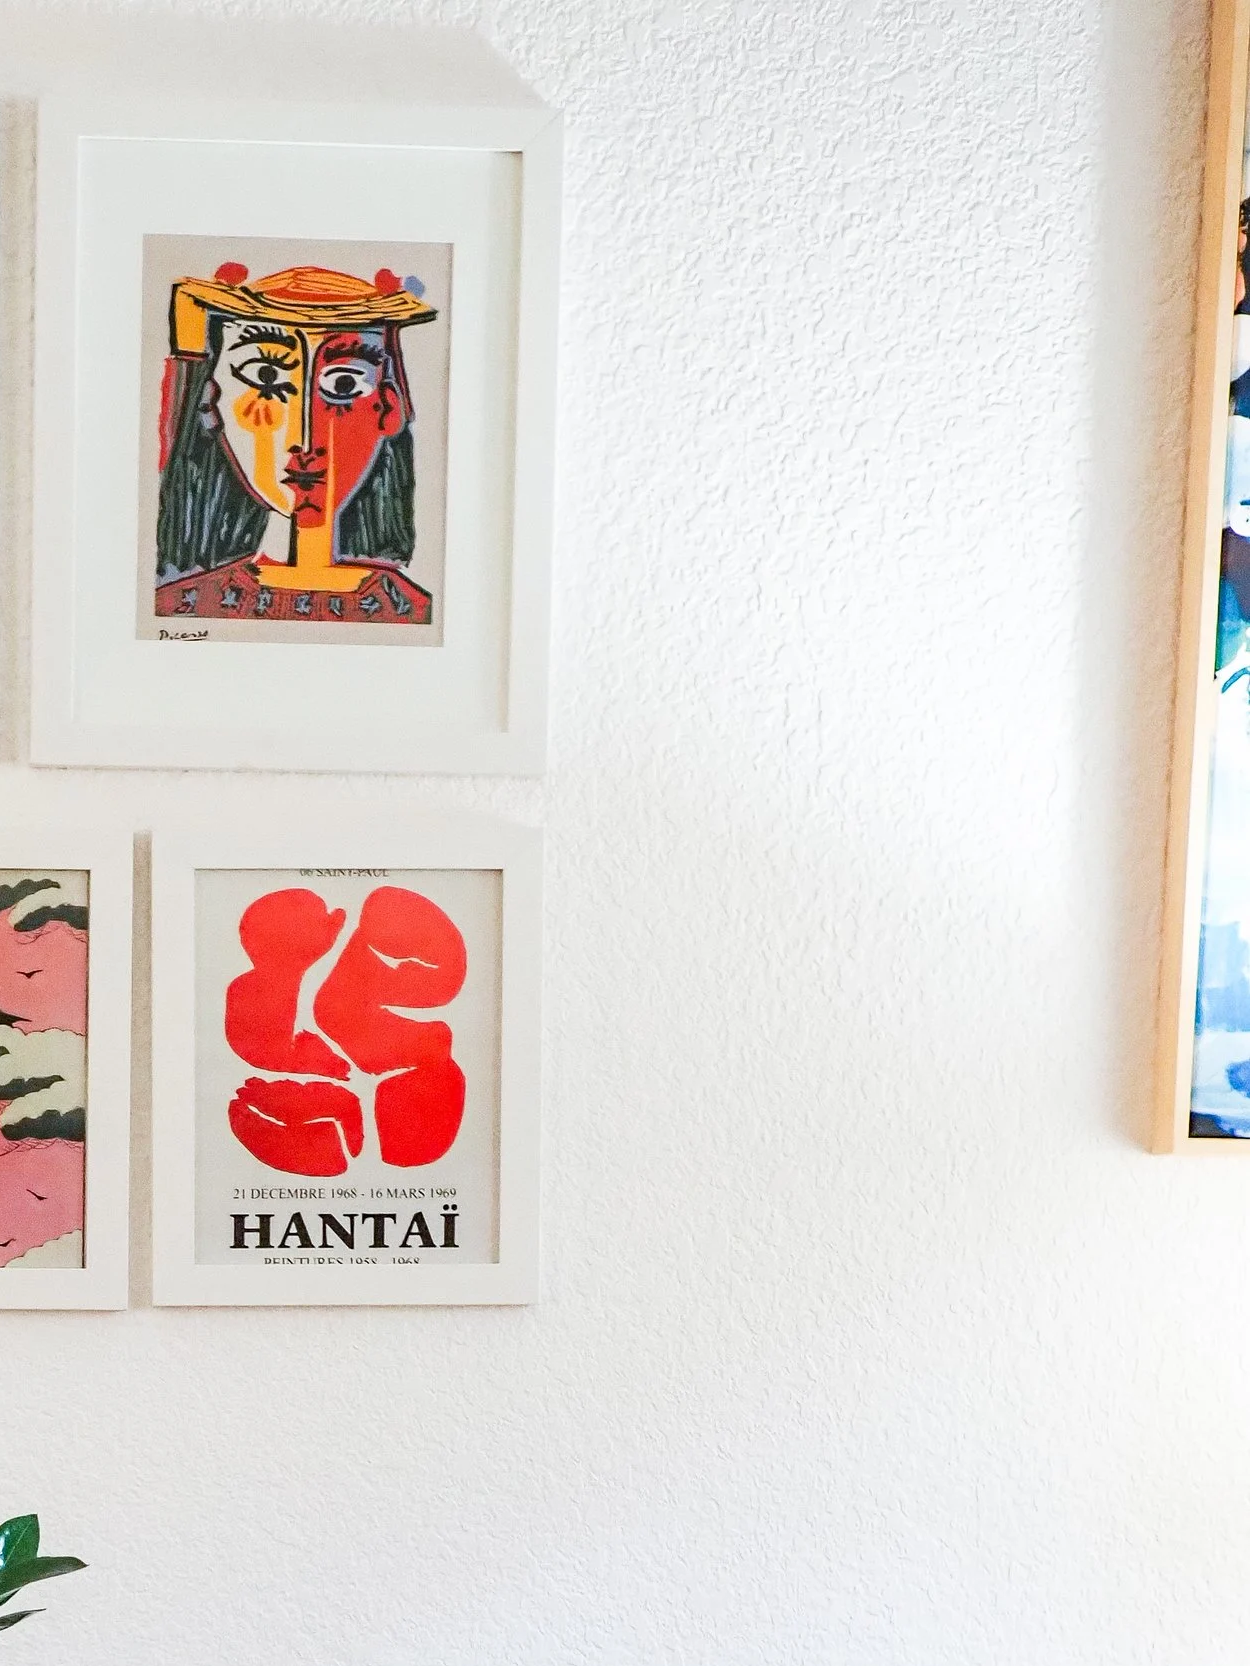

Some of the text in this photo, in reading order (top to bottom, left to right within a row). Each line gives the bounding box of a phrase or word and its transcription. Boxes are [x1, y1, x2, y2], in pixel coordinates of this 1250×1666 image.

[232, 1187, 247, 1200] 21
[250, 1187, 327, 1200] DECEMBRE
[331, 1187, 358, 1200] 1968
[370, 1187, 384, 1199] 16
[386, 1187, 426, 1200] MARS
[430, 1187, 457, 1199] 1969
[228, 1203, 460, 1250] HANTAÏ
[263, 1256, 344, 1265] PEINTURES
